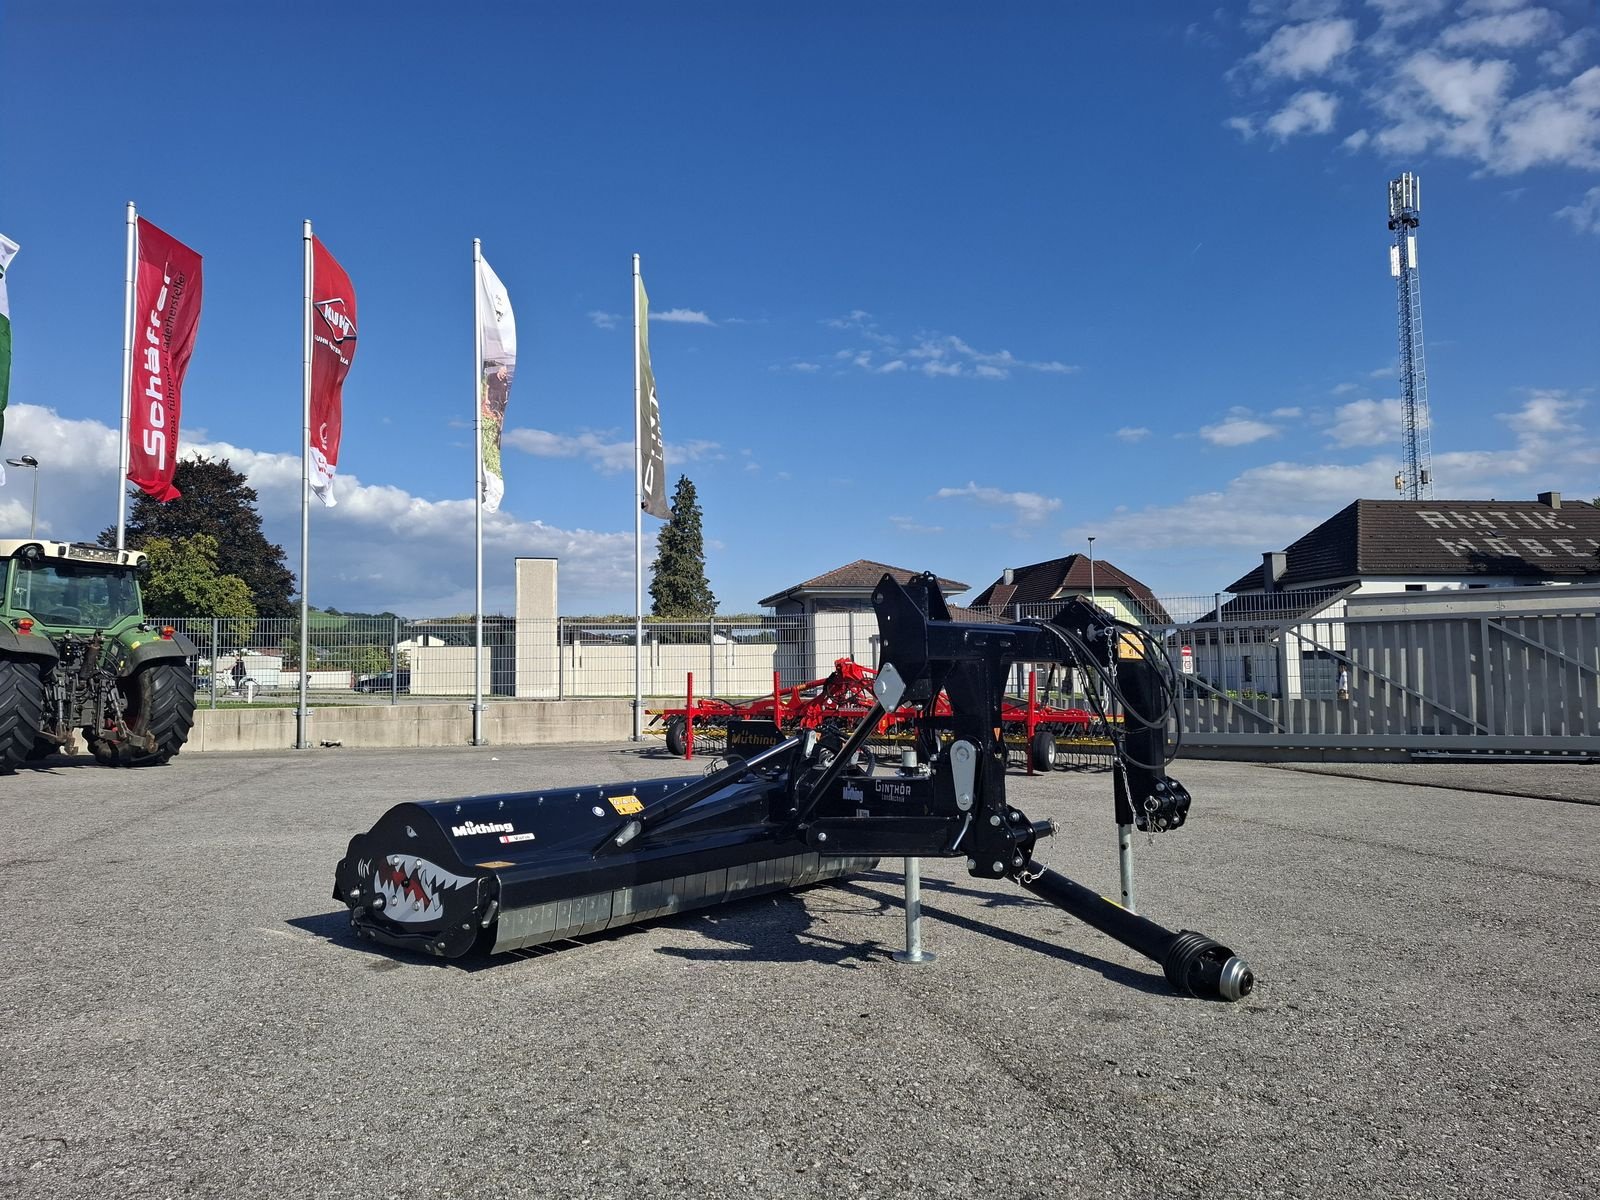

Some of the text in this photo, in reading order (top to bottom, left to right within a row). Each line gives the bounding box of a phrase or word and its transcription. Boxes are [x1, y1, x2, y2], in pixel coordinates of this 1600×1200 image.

[324, 303, 350, 336] KUHN
[143, 261, 171, 471] Schäffer
[1415, 511, 1576, 529] ANTIK
[451, 821, 514, 837] Müthing
